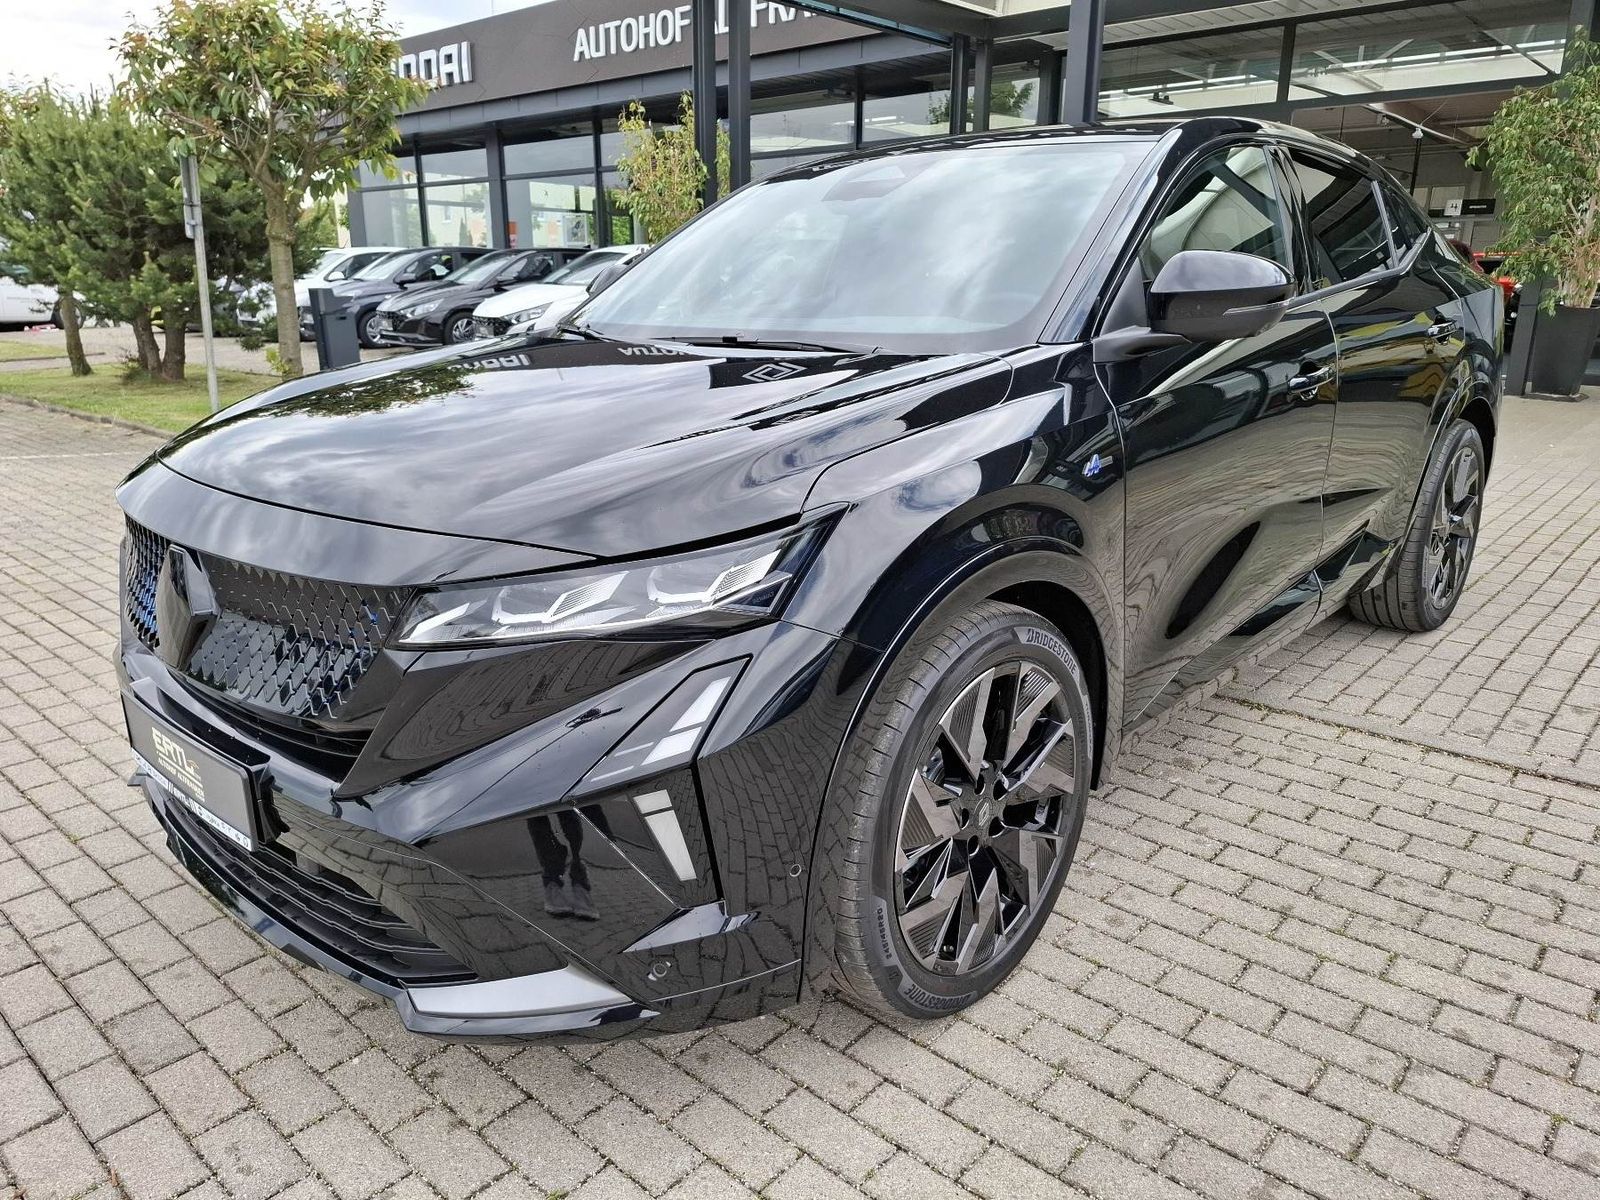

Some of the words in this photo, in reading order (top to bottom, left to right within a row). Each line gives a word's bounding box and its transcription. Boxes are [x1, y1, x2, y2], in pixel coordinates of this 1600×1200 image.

[573, 5, 691, 61] AUTOHOF
[1026, 628, 1077, 675] BRIDGESTONE
[152, 727, 195, 776] ERTL
